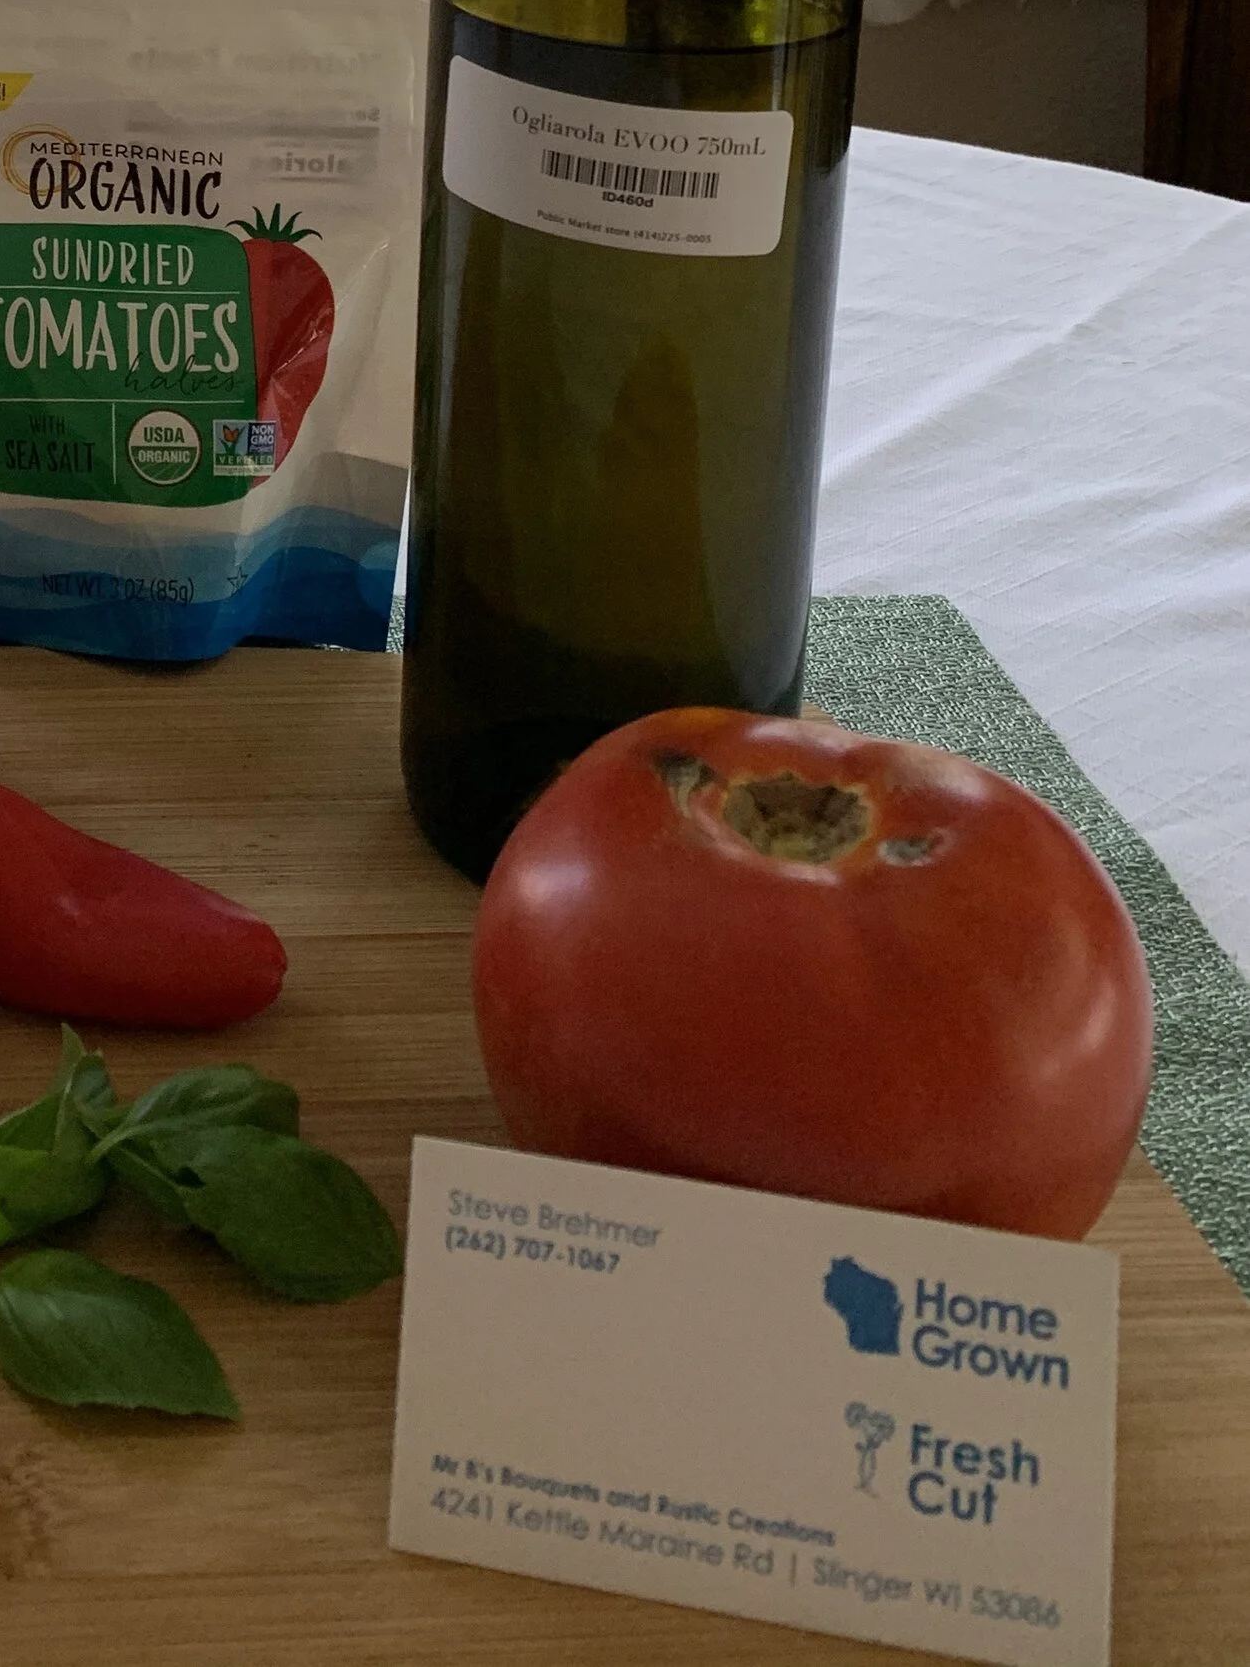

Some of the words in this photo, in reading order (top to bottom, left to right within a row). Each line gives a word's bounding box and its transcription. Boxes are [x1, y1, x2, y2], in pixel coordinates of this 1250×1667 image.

[29, 141, 224, 167] MEDITERRANEAN
[512, 105, 605, 144] Ogliarola
[614, 128, 689, 154] EVOO
[697, 136, 766, 157] 750mL
[29, 157, 223, 220] ORGANIC
[602, 191, 654, 208] ID460d
[537, 208, 565, 224] Public
[568, 218, 601, 233] Market
[605, 225, 630, 237] store
[32, 236, 194, 285] SUNDRIED
[29, 413, 66, 434] WITH
[143, 426, 185, 444] USDA
[250, 435, 274, 445] GMO
[251, 424, 274, 435] NON
[5, 439, 41, 471] SEA
[48, 442, 95, 473] SALT
[138, 449, 190, 464] ORGANIC
[43, 573, 71, 596] NET
[125, 577, 145, 600] OZ
[150, 577, 195, 606] (85g)
[448, 1188, 530, 1227] Steve
[537, 1203, 663, 1248] Brehmer
[444, 1225, 507, 1261] (262)
[513, 1236, 621, 1274] 707-1067
[915, 1277, 1058, 1341] Home
[912, 1324, 1070, 1390] Grown
[910, 1423, 1040, 1487] Fresh
[605, 1490, 651, 1513] and
[727, 1506, 837, 1547] Creations
[908, 1470, 998, 1525] Cut
[431, 1487, 494, 1523] 4241
[732, 1541, 775, 1577] Rd
[812, 1556, 913, 1604] Slinger
[923, 1580, 962, 1613] WI
